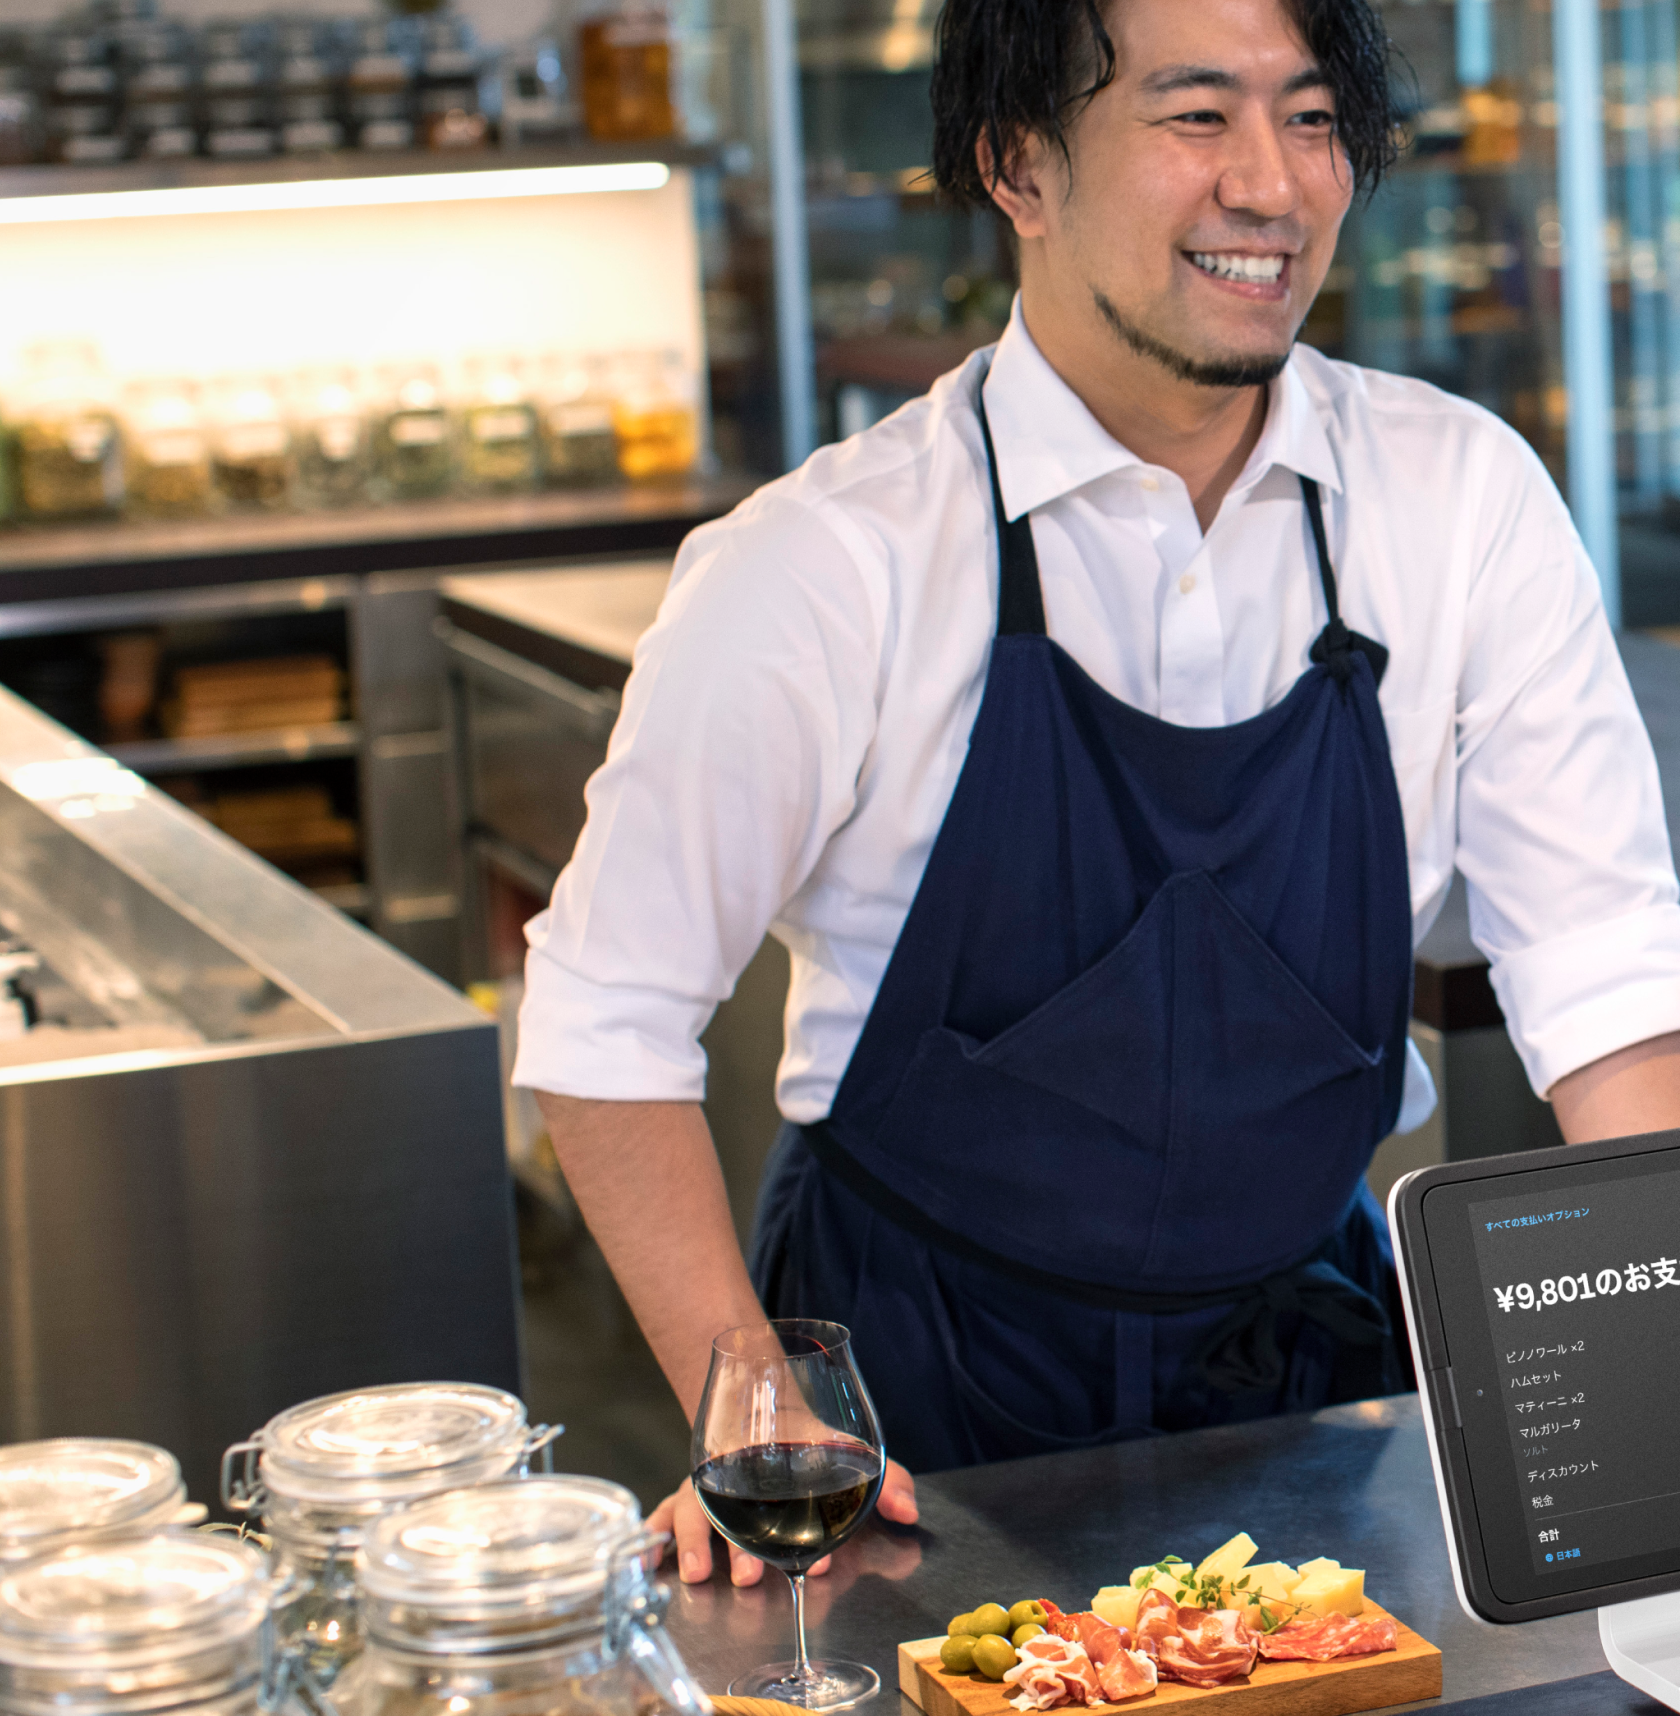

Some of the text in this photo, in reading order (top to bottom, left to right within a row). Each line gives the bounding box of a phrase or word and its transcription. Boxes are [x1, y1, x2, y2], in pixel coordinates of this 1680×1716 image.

[1484, 1207, 1590, 1232] すべての支払いオプション
[1506, 1344, 1568, 1364] ピノノワール
[1510, 1370, 1562, 1388] ハムセット
[1514, 1396, 1568, 1413] マティーニ
[1519, 1418, 1581, 1438] マルガリータ
[1523, 1445, 1549, 1457] ソルト
[1527, 1460, 1599, 1483] ディスカウント
[1531, 1494, 1554, 1509] 税金
[1538, 1528, 1560, 1543] 合計
[1556, 1548, 1582, 1561] 日本語
